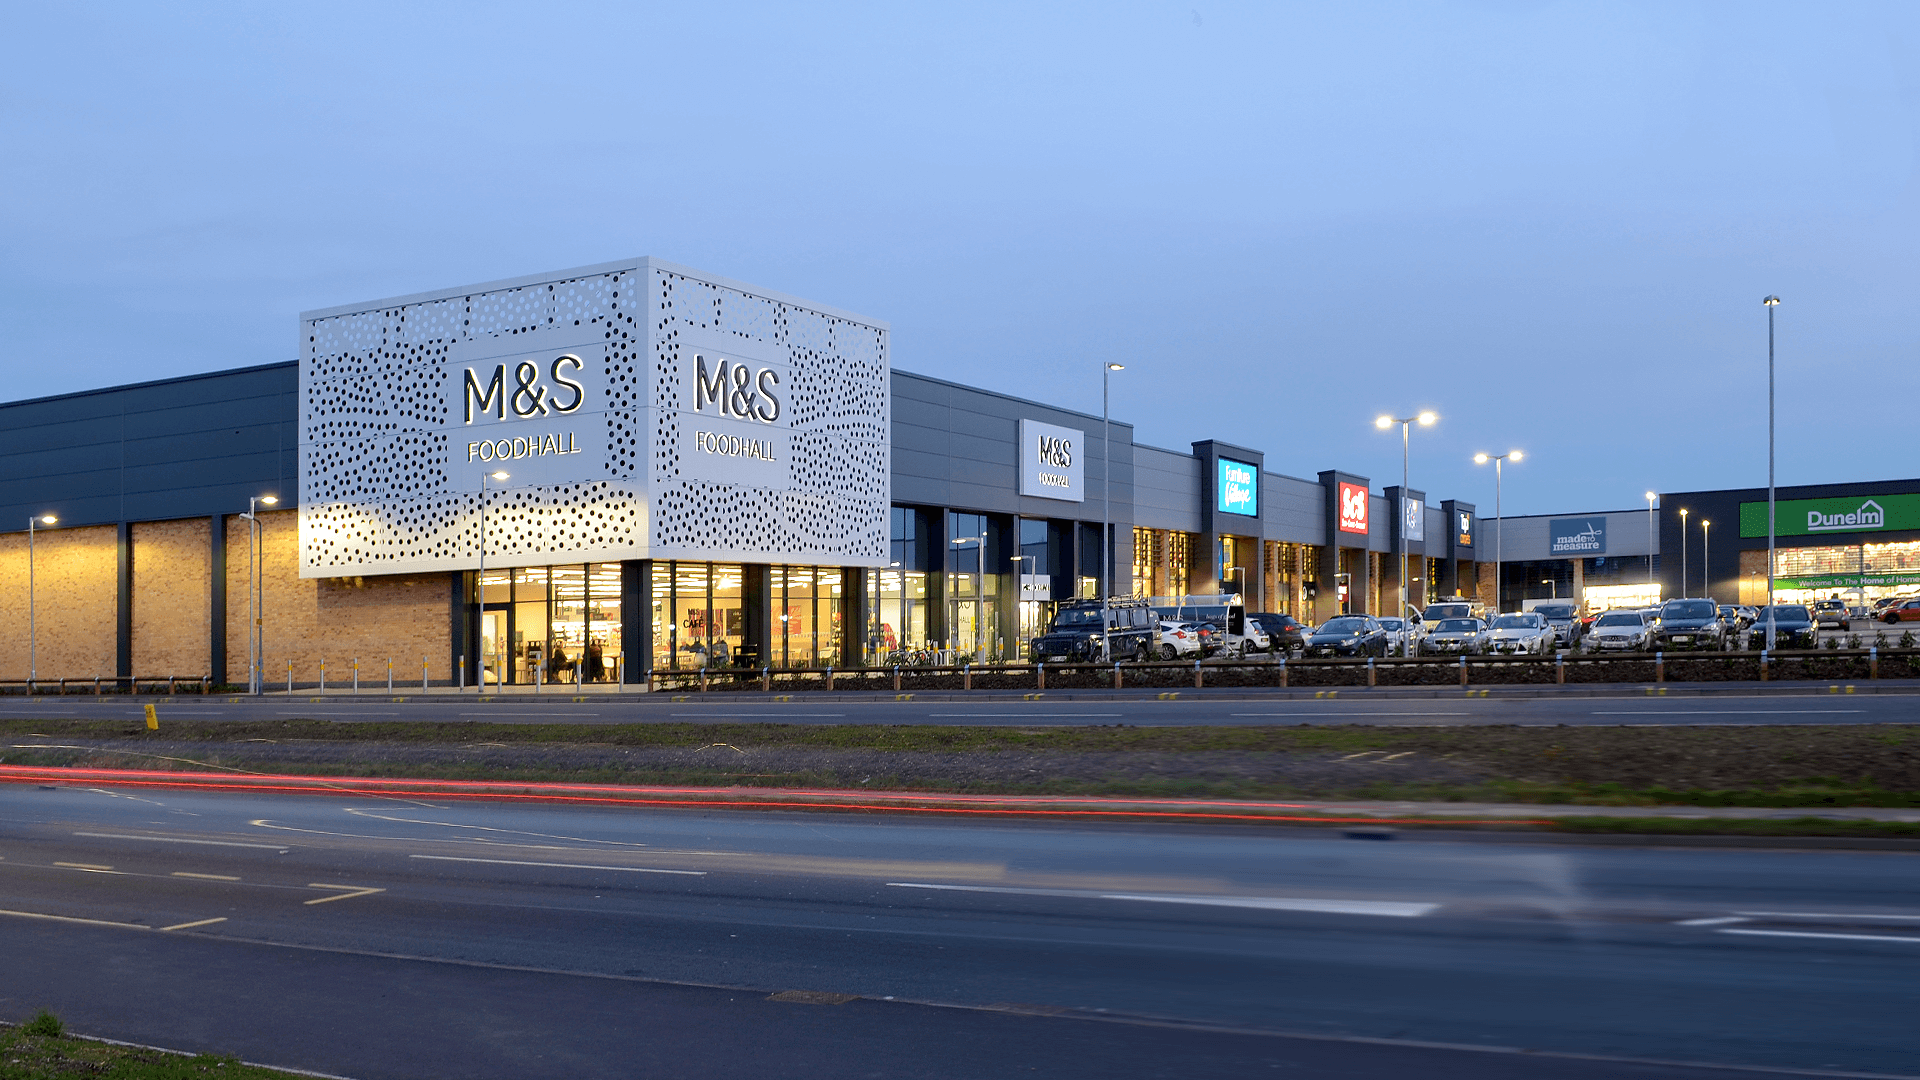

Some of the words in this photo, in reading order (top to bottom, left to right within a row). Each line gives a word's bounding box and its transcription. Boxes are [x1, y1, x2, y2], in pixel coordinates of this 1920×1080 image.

[464, 354, 584, 424] M&S
[693, 354, 780, 423] M&S
[467, 431, 581, 462] FOODHALL
[695, 430, 777, 461] FOODHALL
[1039, 434, 1072, 468] M&S
[1807, 505, 1882, 528] Dunelm
[1553, 541, 1600, 551] measure
[1556, 534, 1587, 544] made
[1799, 579, 1832, 587] Welcome
[1860, 576, 1885, 584] Home
[1886, 575, 1896, 583] of
